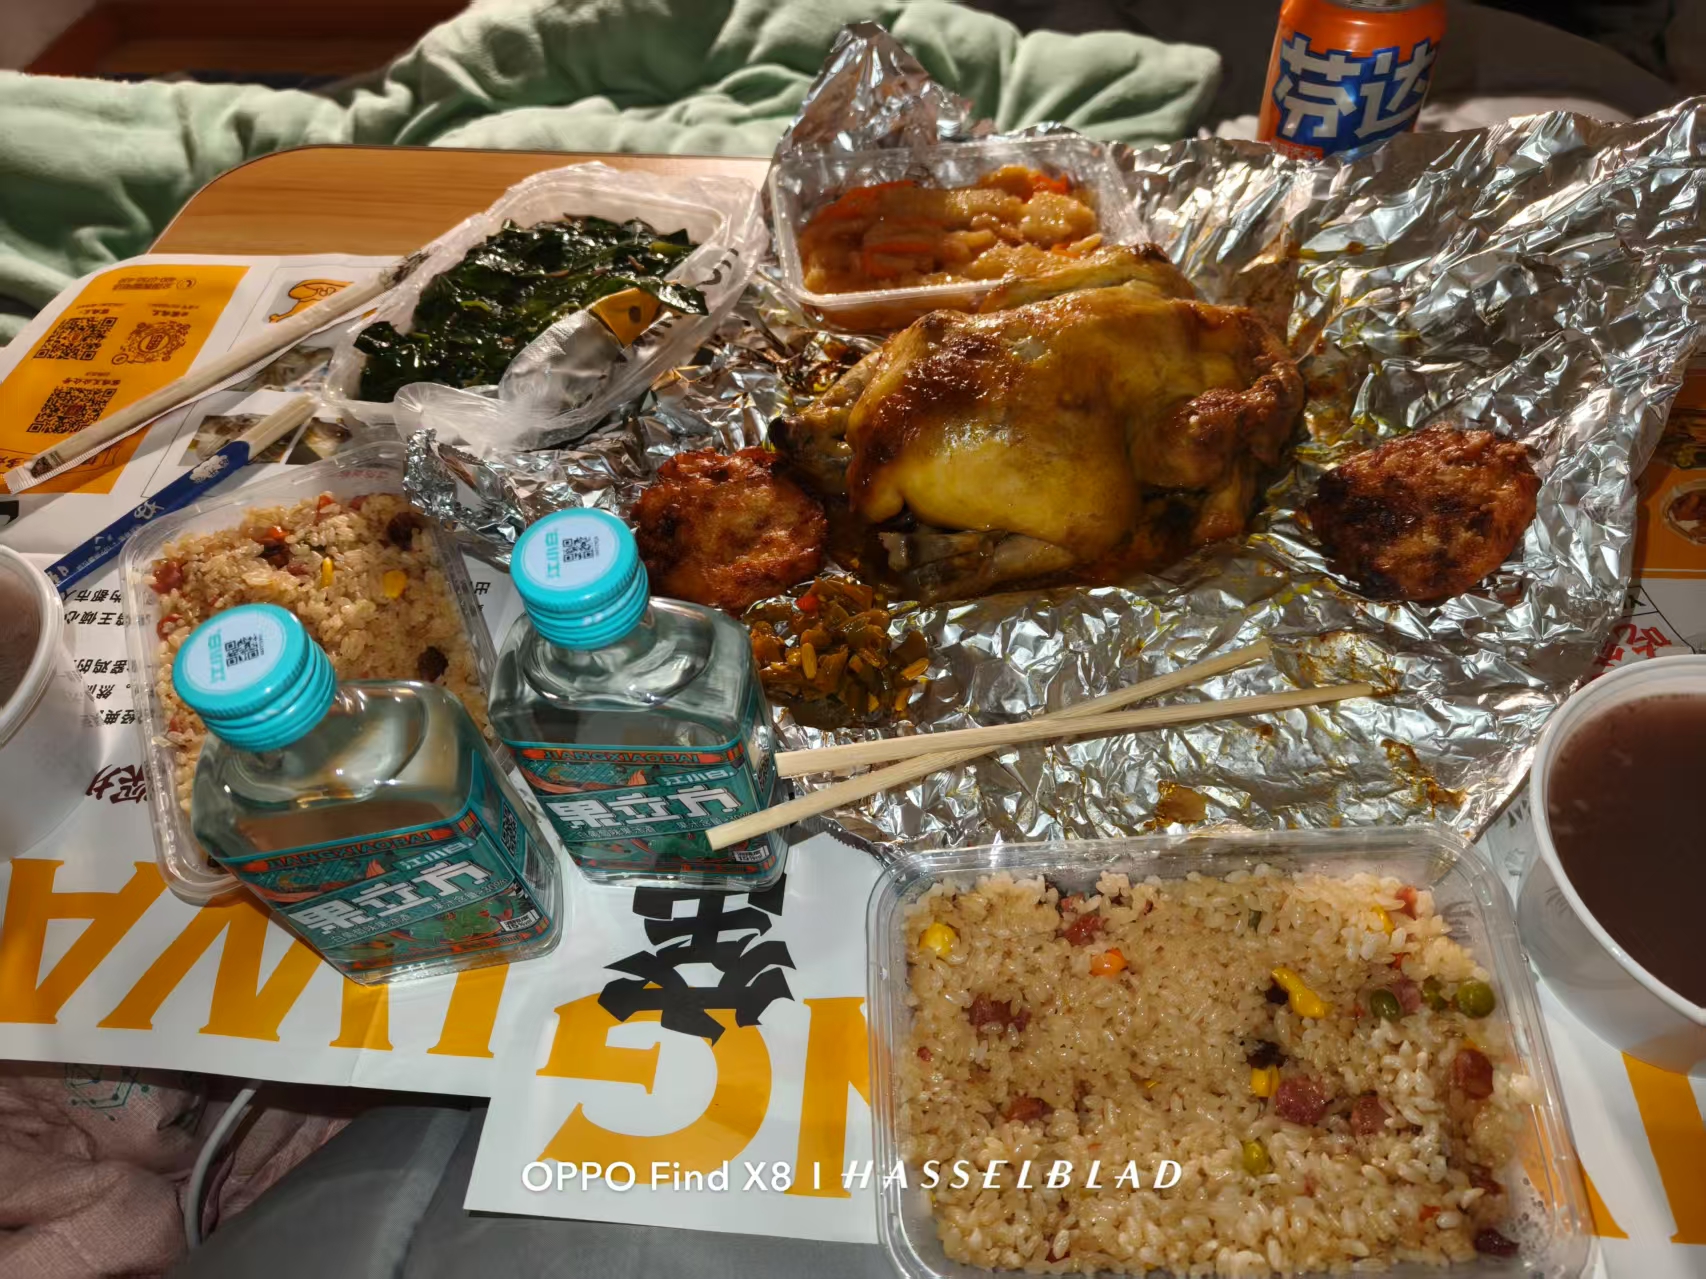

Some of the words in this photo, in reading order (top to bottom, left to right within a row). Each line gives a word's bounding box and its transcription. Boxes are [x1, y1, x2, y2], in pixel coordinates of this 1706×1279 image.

[1275, 34, 1437, 140] 芬达
[544, 750, 699, 763] JIANGXIAOBAI
[662, 770, 728, 785] 江小白
[546, 785, 741, 829] 果立方
[267, 832, 433, 869] JIANGXIAOBAI
[398, 842, 467, 871] 江小白
[288, 860, 493, 933] 果立方
